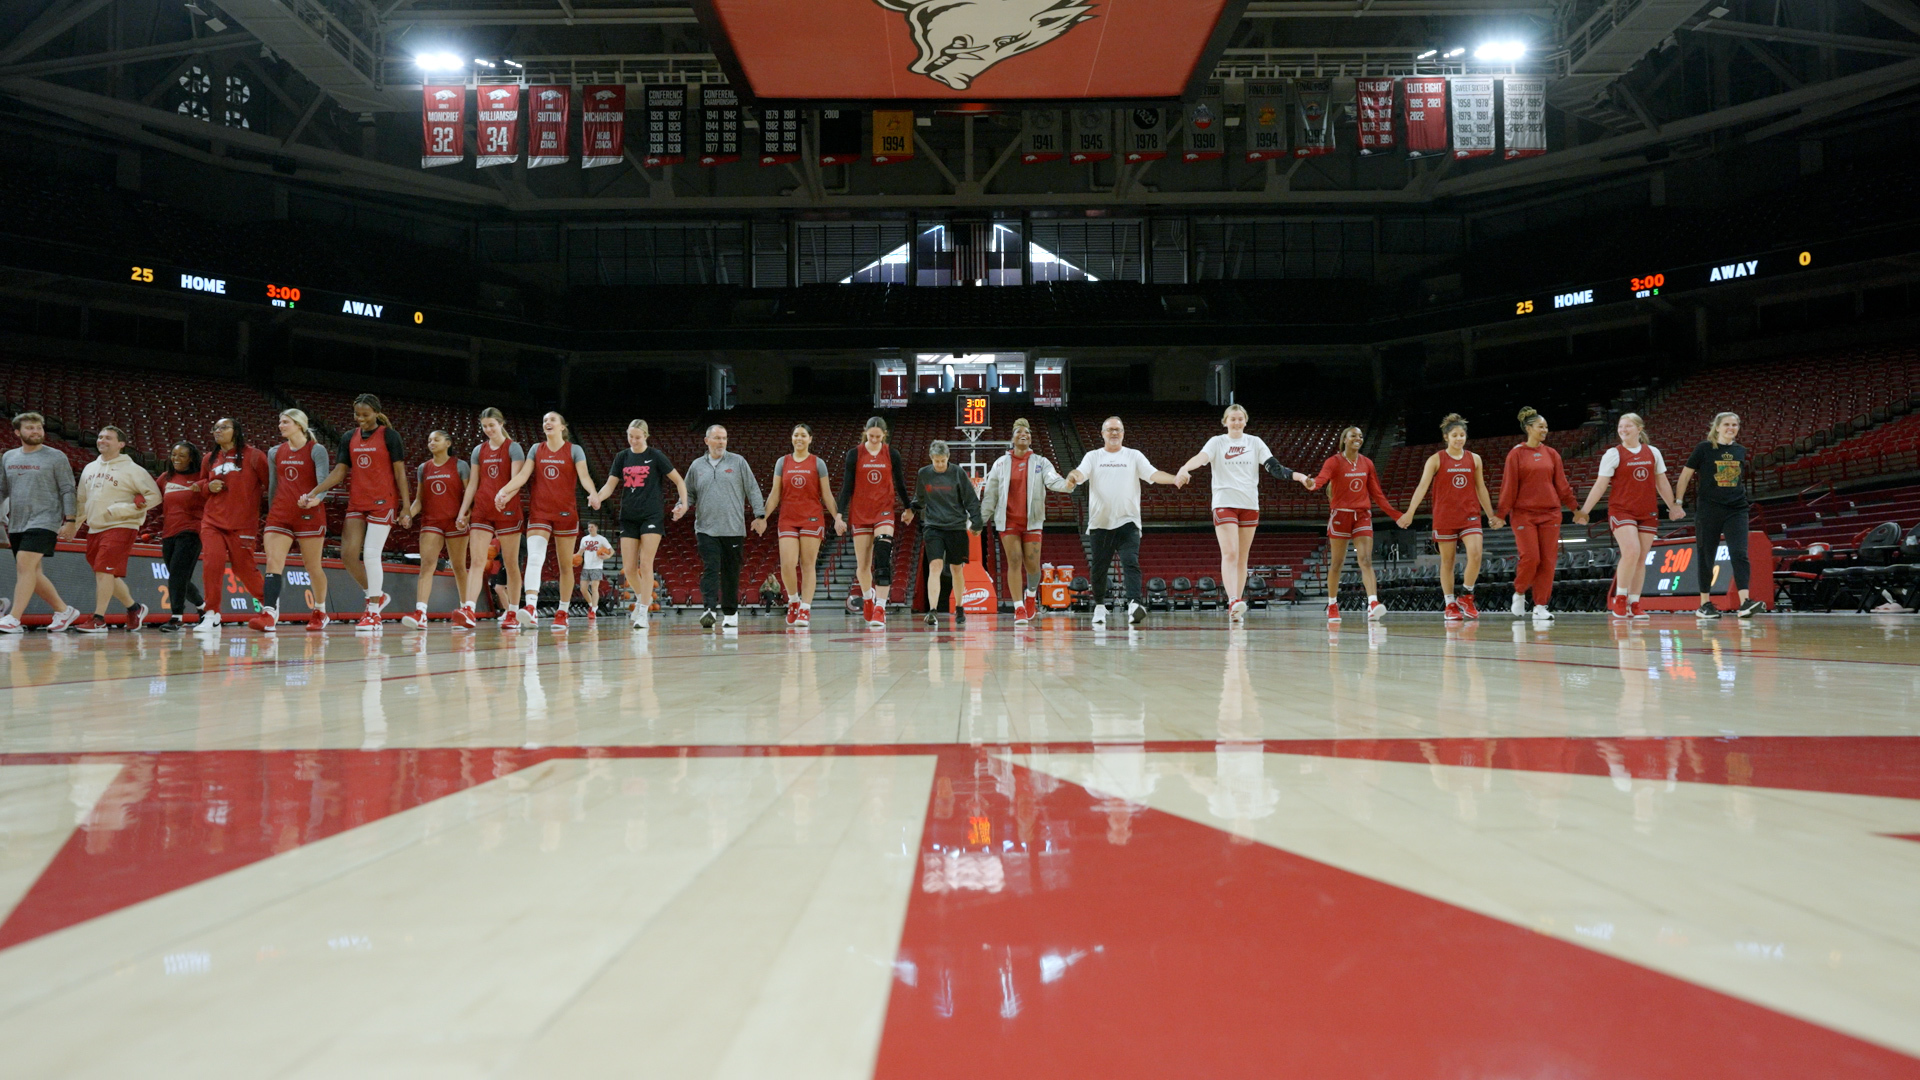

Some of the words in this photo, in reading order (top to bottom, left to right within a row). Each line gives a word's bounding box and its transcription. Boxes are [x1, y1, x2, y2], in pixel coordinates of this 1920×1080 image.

[1249, 85, 1265, 94] FINAL
[1267, 85, 1283, 94] FOUR
[1359, 82, 1375, 92] ELITE
[1408, 83, 1423, 93] ELITE
[1425, 83, 1442, 93] EIGHT
[649, 90, 683, 99] CONFERENCE
[1427, 98, 1441, 107] 2021
[1458, 99, 1471, 107] 1958
[1475, 99, 1488, 107] 1978
[428, 112, 459, 122] MONCRIEF
[478, 111, 518, 121] WILLIAMSON
[538, 112, 561, 122] SUTTON
[584, 112, 623, 122] RICHARDSON
[705, 111, 719, 120] 1941
[723, 111, 736, 120] 1942
[765, 110, 778, 119] 1979
[824, 110, 839, 119] 2000
[1410, 111, 1424, 120] 2022
[1476, 111, 1489, 120] 1981
[705, 121, 719, 130] 1944
[433, 127, 453, 152] 32
[487, 126, 508, 152] 34
[883, 137, 904, 151] 1994
[1032, 135, 1053, 149] 1941
[1080, 135, 1102, 149] 1945
[1136, 134, 1157, 149] 1978
[1192, 134, 1215, 148] 1990
[1256, 132, 1278, 147] 1994
[1460, 137, 1472, 145] 1991
[705, 143, 719, 152] 1977
[1799, 252, 1811, 266] 0
[131, 267, 154, 283] 25
[1710, 260, 1758, 282] AWAY
[181, 274, 226, 294] HOME
[1631, 274, 1664, 291] 3:00
[267, 284, 300, 301] 3:00
[1554, 290, 1593, 308] HOME
[1636, 290, 1650, 298] QTR
[272, 300, 286, 308] QTR
[342, 300, 383, 318] AWAY
[1516, 300, 1533, 315] 25
[414, 312, 424, 324] 0
[966, 399, 986, 408] 3:00
[964, 408, 984, 424] 30
[1636, 470, 1646, 478] 44
[436, 483, 441, 491] 0
[1660, 548, 1692, 573] 3:00
[151, 563, 169, 580] HO
[287, 571, 310, 585] GUES
[1672, 576, 1681, 590] 5
[158, 585, 171, 609] 2
[305, 589, 314, 609] 0
[1052, 588, 1064, 601] G
[231, 598, 247, 610] QTR
[252, 598, 261, 612] 5
